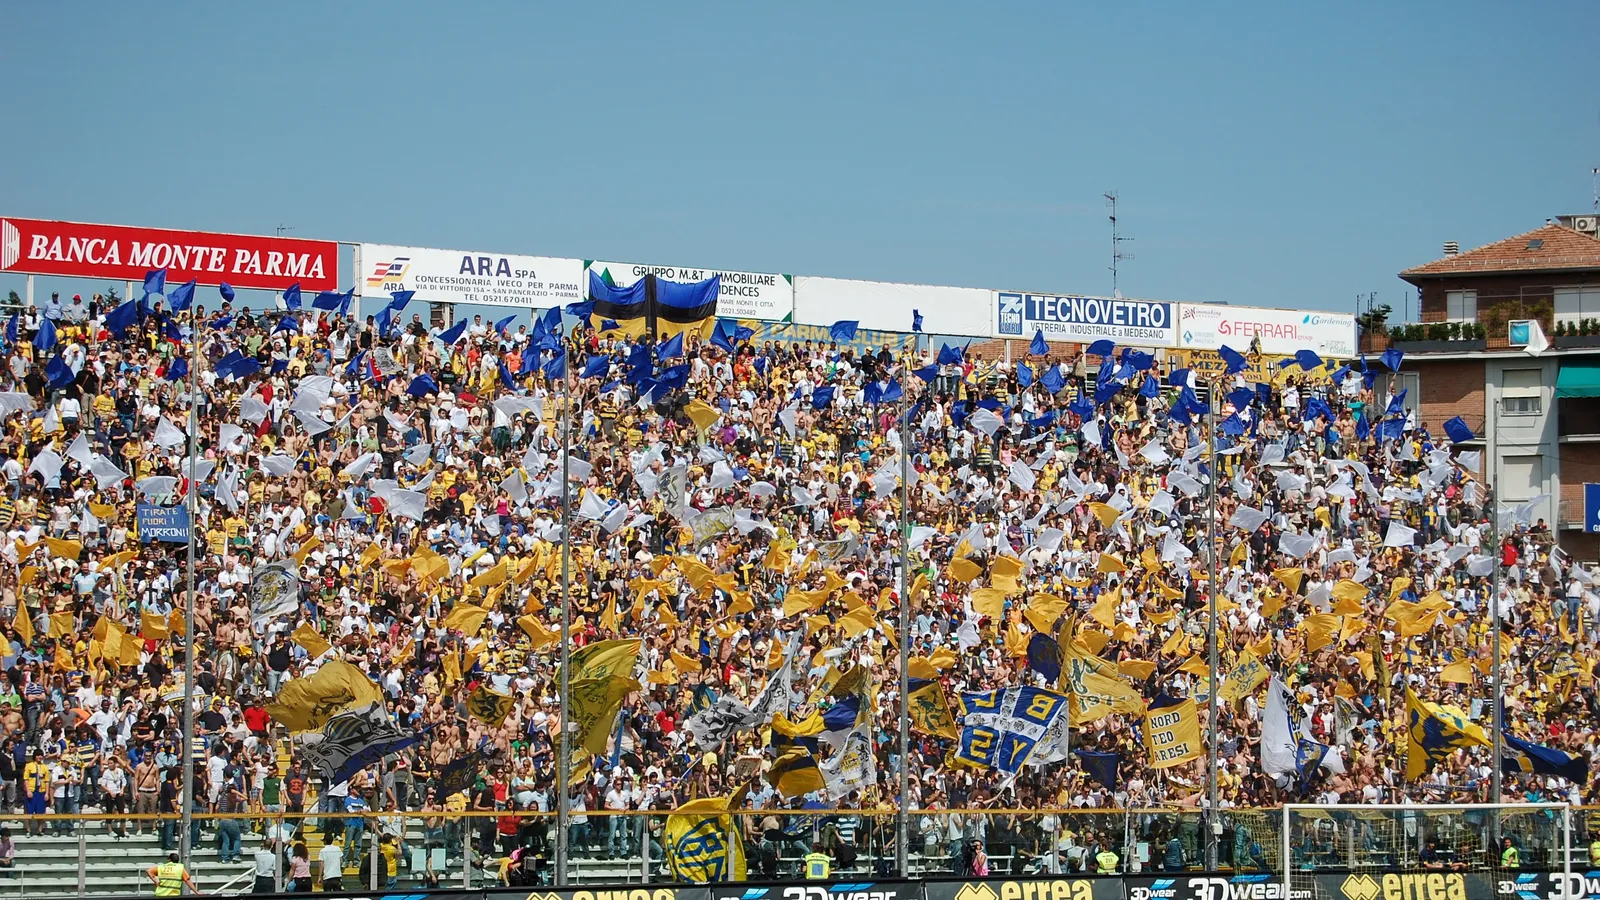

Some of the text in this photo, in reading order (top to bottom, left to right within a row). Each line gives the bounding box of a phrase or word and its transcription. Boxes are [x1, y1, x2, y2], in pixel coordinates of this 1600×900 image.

[28, 234, 326, 279] BANCA MONTE PARMA
[459, 256, 536, 279] ARA SPA
[383, 282, 405, 291] ARA
[415, 275, 579, 291] CONCESSIONARIA IVECO PER PARMA
[482, 295, 532, 304] 0521.670411
[1000, 312, 1020, 323] TECNO
[1030, 295, 1165, 328] TECNOVETRO
[1311, 315, 1352, 327] Gardening
[1030, 322, 1067, 333] VETRERIA
[1070, 325, 1117, 336] INDUSTRIALE
[1124, 328, 1164, 339] MEDESANO
[1234, 321, 1297, 339] FERRARI
[141, 508, 178, 516] TIRATE
[1150, 711, 1181, 729] NORD
